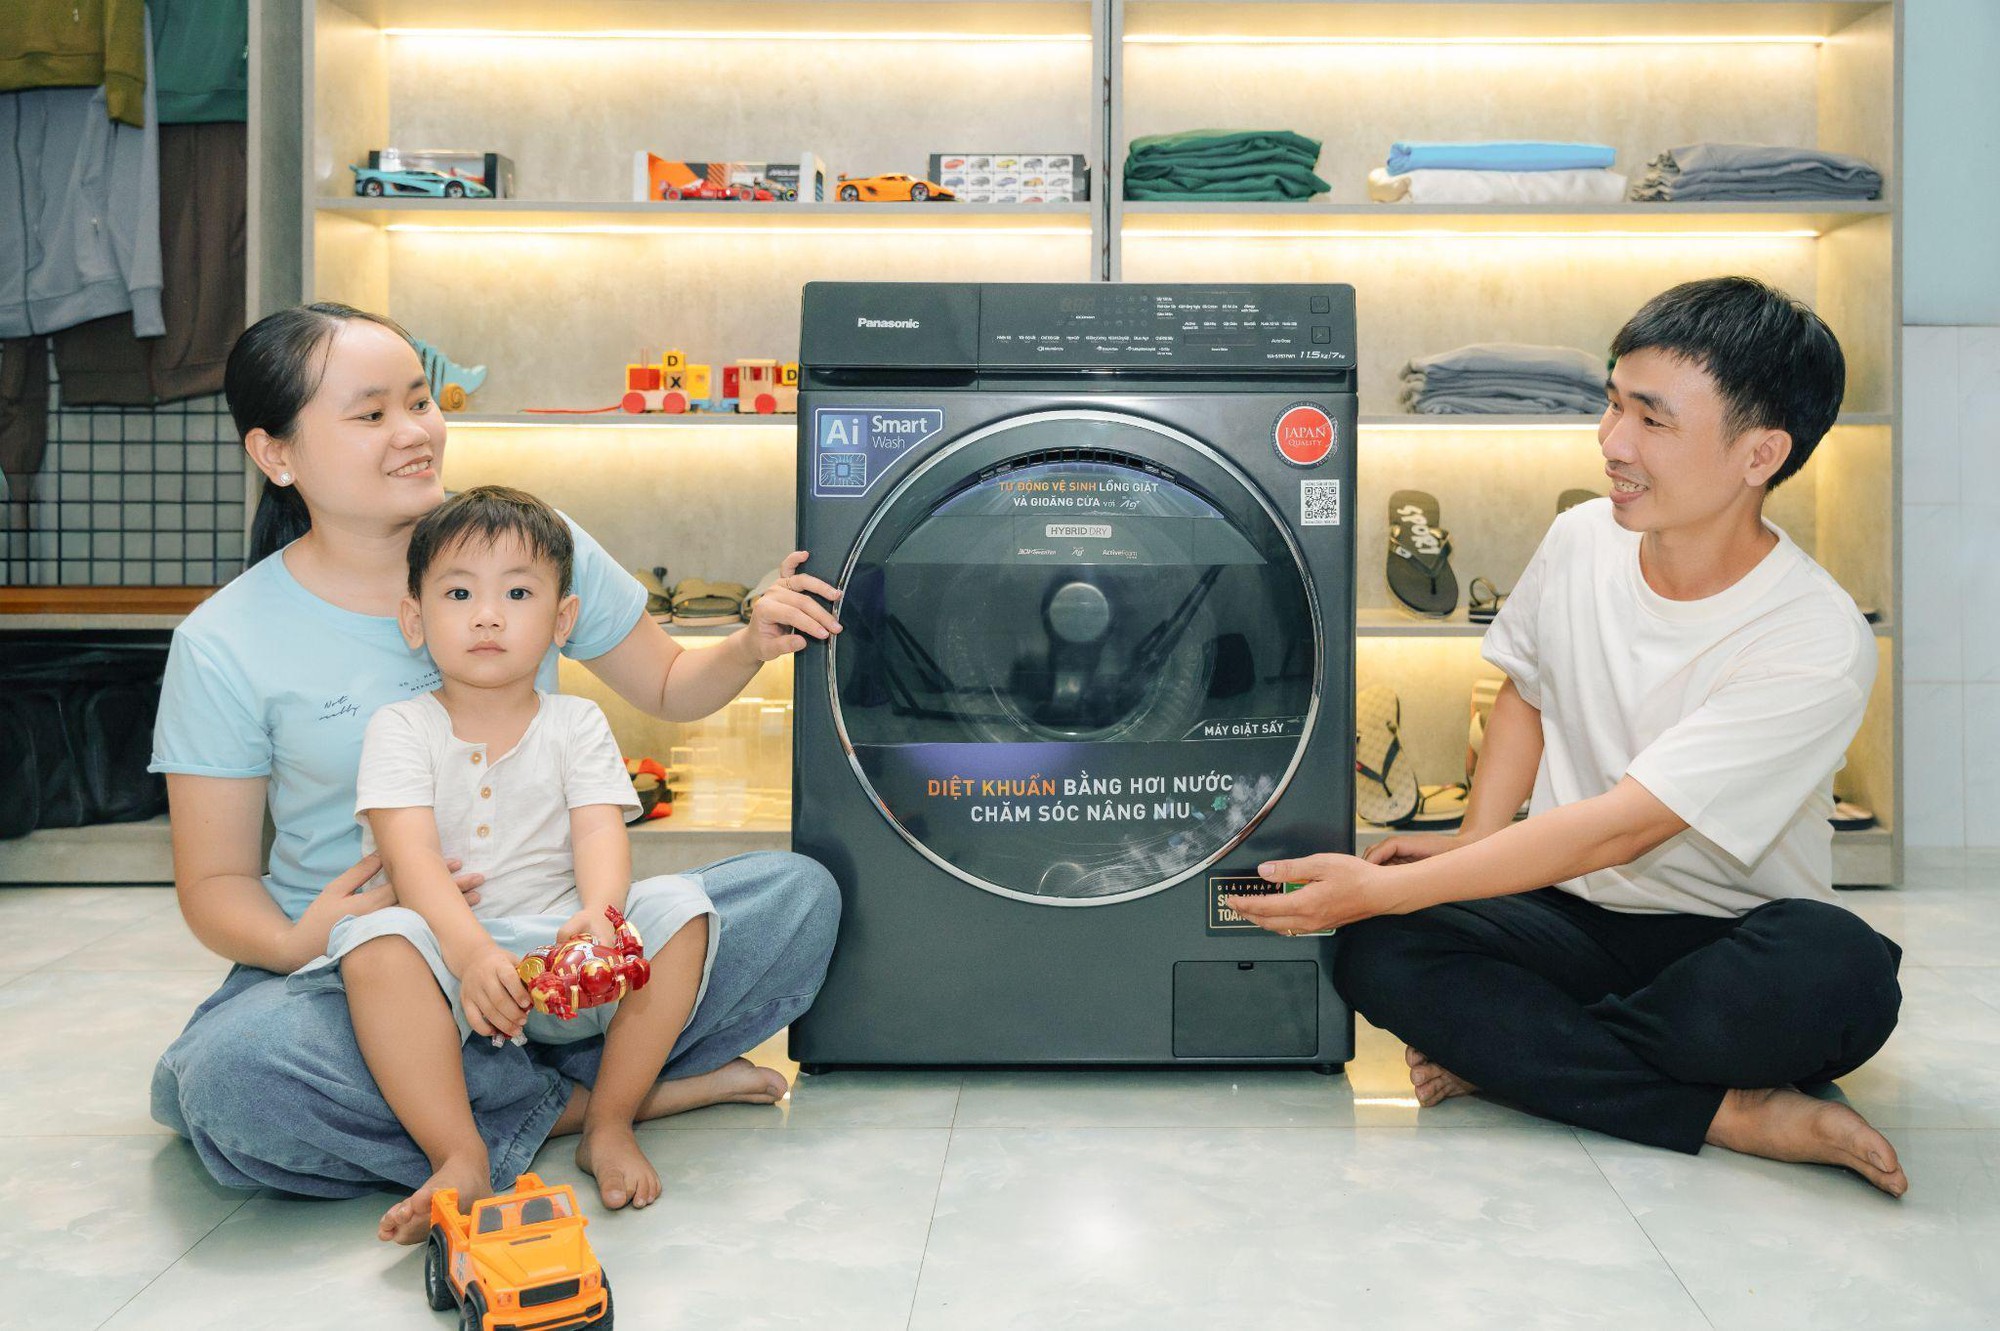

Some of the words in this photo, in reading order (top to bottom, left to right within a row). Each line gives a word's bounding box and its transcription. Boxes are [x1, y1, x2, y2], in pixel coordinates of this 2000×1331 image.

[858, 318, 919, 329] Panasonic
[667, 355, 678, 366] D
[670, 376, 681, 388] X
[872, 415, 928, 433] Smart
[1285, 426, 1326, 439] JAPAN
[872, 436, 905, 448] Wash
[1288, 439, 1322, 448] QUALITY
[1017, 481, 1049, 493] ĐỘNG
[1052, 480, 1066, 492] VỆ
[1069, 482, 1096, 492] SINH
[1100, 479, 1129, 492] LỒNG
[1133, 481, 1159, 493] GIẶT
[1013, 495, 1028, 507] VÀ
[1030, 495, 1074, 507] GIOĂNG
[1076, 495, 1100, 507] CỬA
[1051, 526, 1088, 536] HYBRID
[1089, 527, 1108, 536] DRY
[1204, 723, 1229, 736] MÁY
[1232, 722, 1258, 737] GIẶT
[928, 775, 975, 800] DIỆT
[982, 772, 1056, 796] KHUẨN
[1063, 770, 1122, 796] BẰNG
[1130, 776, 1165, 794] HƠI
[1173, 770, 1233, 793] NƯỚC
[971, 801, 1030, 822] CHĂM
[1038, 801, 1079, 822] SÓC
[1087, 800, 1146, 821] NÂNG
[1153, 802, 1190, 820] NIU
